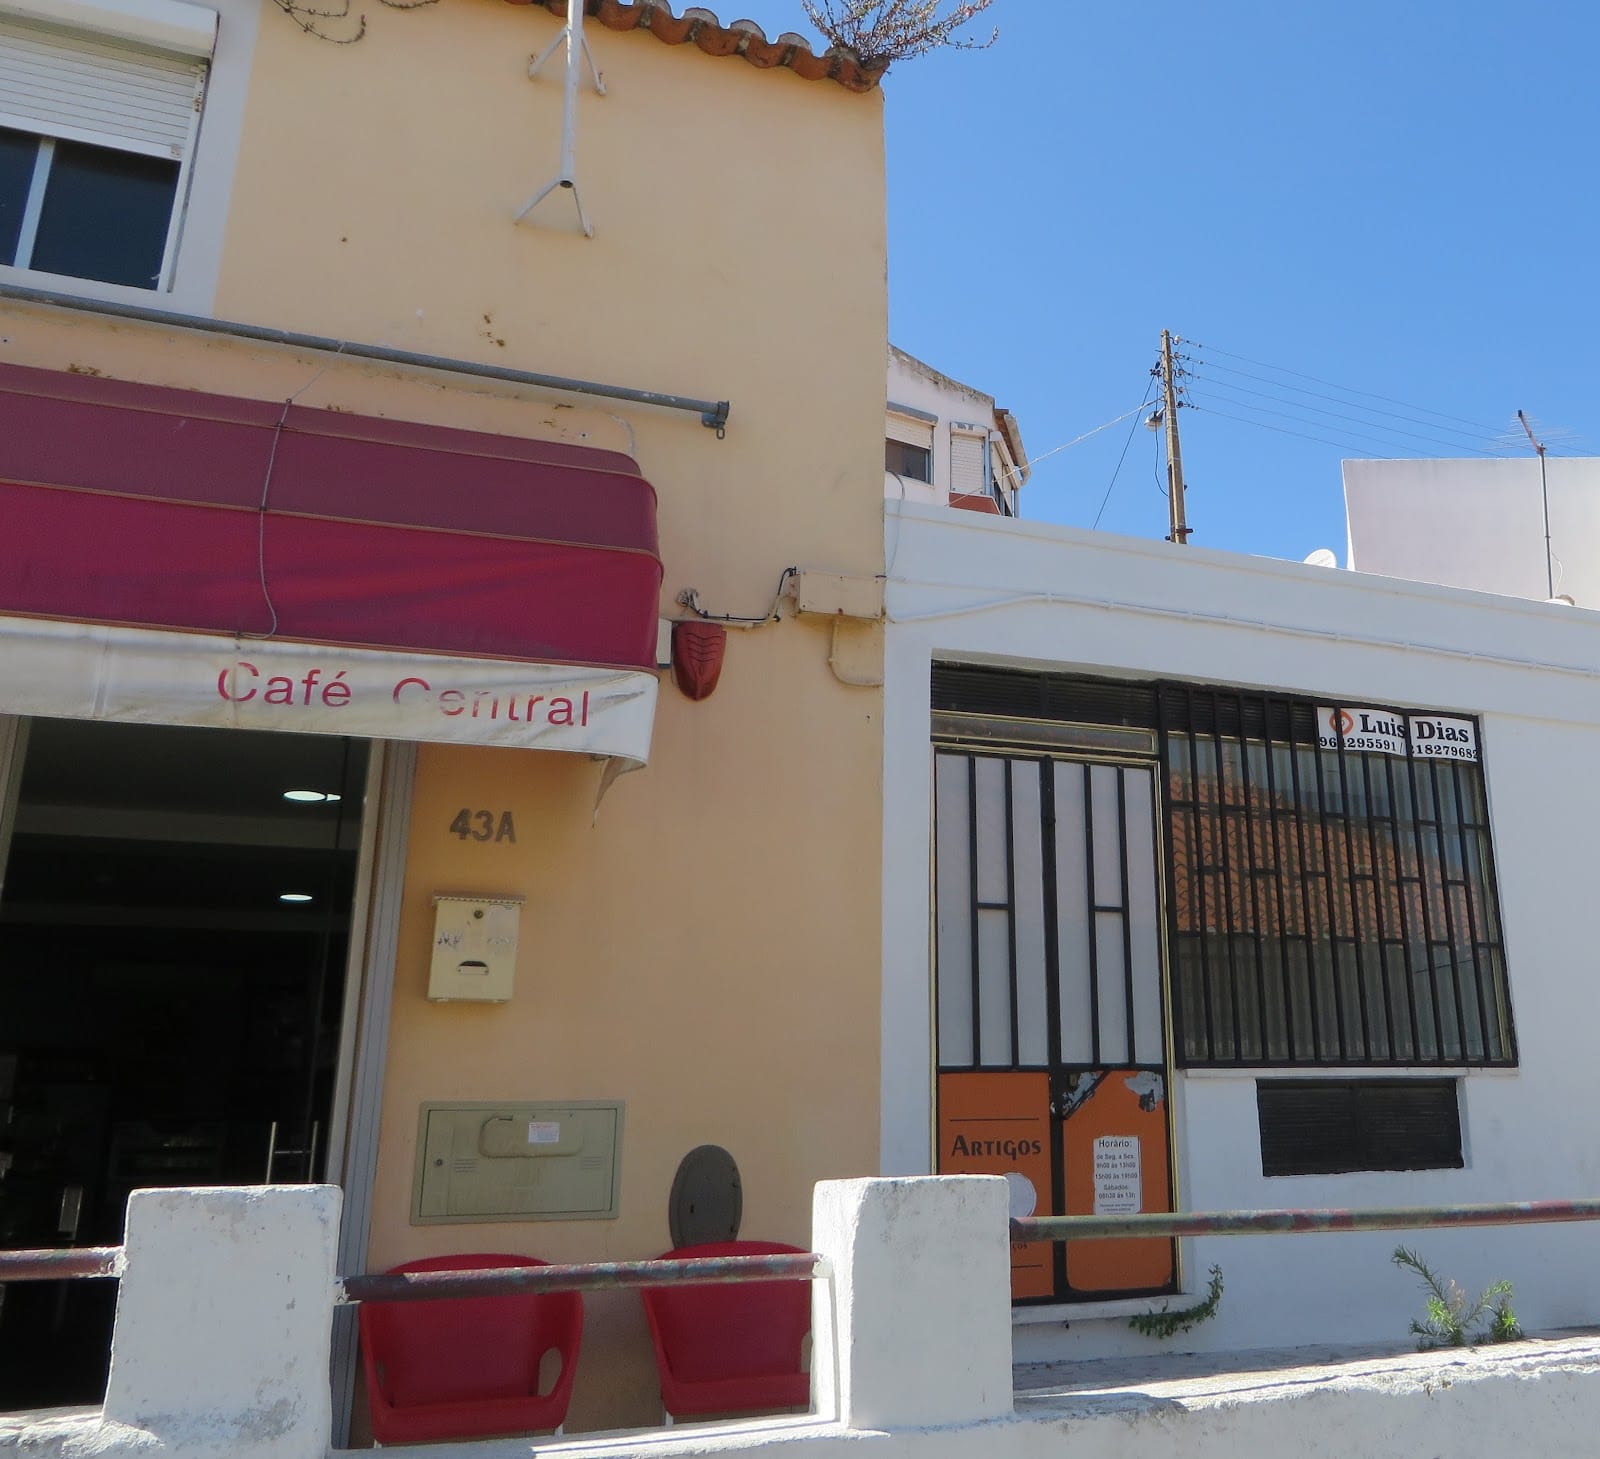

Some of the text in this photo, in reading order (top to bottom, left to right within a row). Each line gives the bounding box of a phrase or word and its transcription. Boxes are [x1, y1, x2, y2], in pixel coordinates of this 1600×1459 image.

[218, 662, 589, 727] Café Central
[1359, 714, 1470, 742] Luis Dias
[1320, 736, 1397, 752] 96295591
[449, 808, 517, 843] 43A
[1098, 1139, 1133, 1148] Horário:
